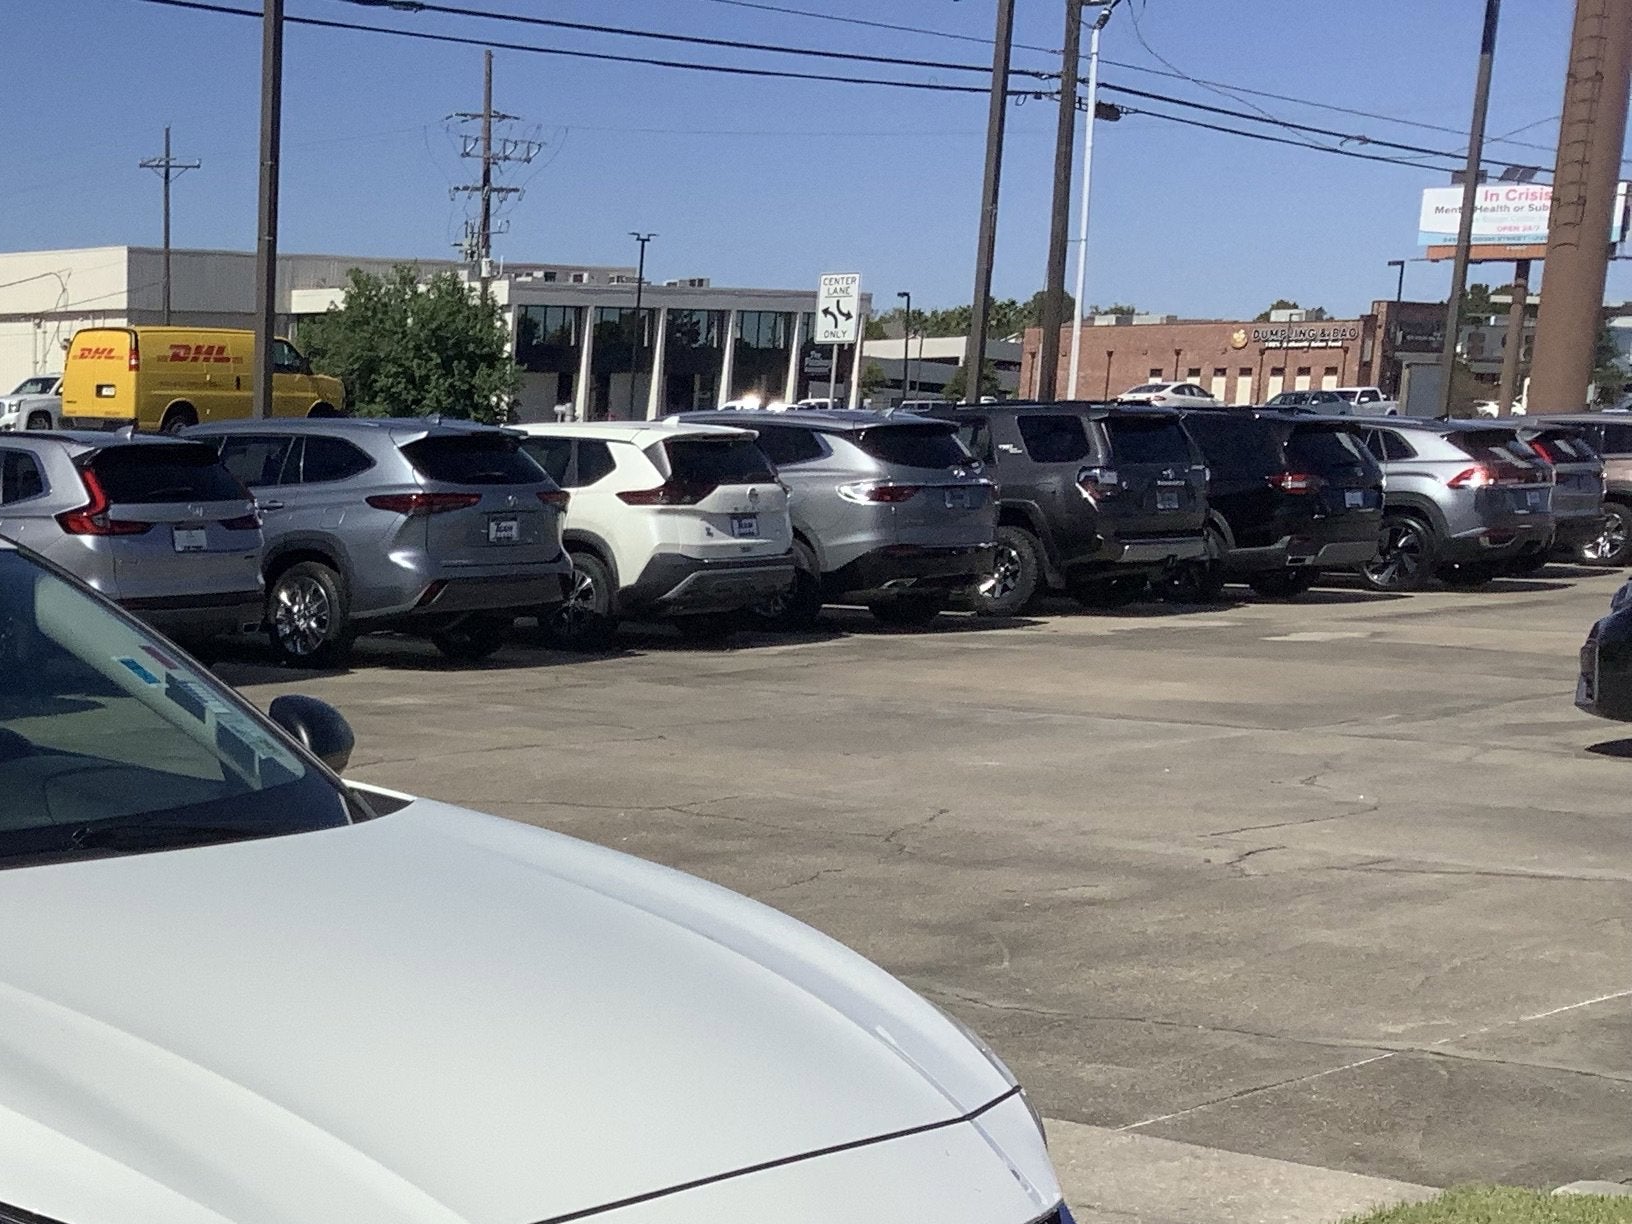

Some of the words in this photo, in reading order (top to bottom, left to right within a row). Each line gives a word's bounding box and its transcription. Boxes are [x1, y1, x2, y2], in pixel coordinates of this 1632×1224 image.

[1484, 189, 1499, 202] In
[1505, 187, 1553, 201] Crisis
[1434, 205, 1462, 215] Ment
[1474, 203, 1511, 214] Health
[1513, 206, 1524, 214] or
[823, 276, 857, 286] CENTER
[827, 286, 851, 295] LANE
[824, 330, 847, 339] ONLY
[1253, 328, 1318, 340] DUMPLING
[1320, 328, 1330, 339] &
[1332, 327, 1358, 340] BAO
[78, 347, 116, 359] DHL
[169, 344, 231, 363] DHL
